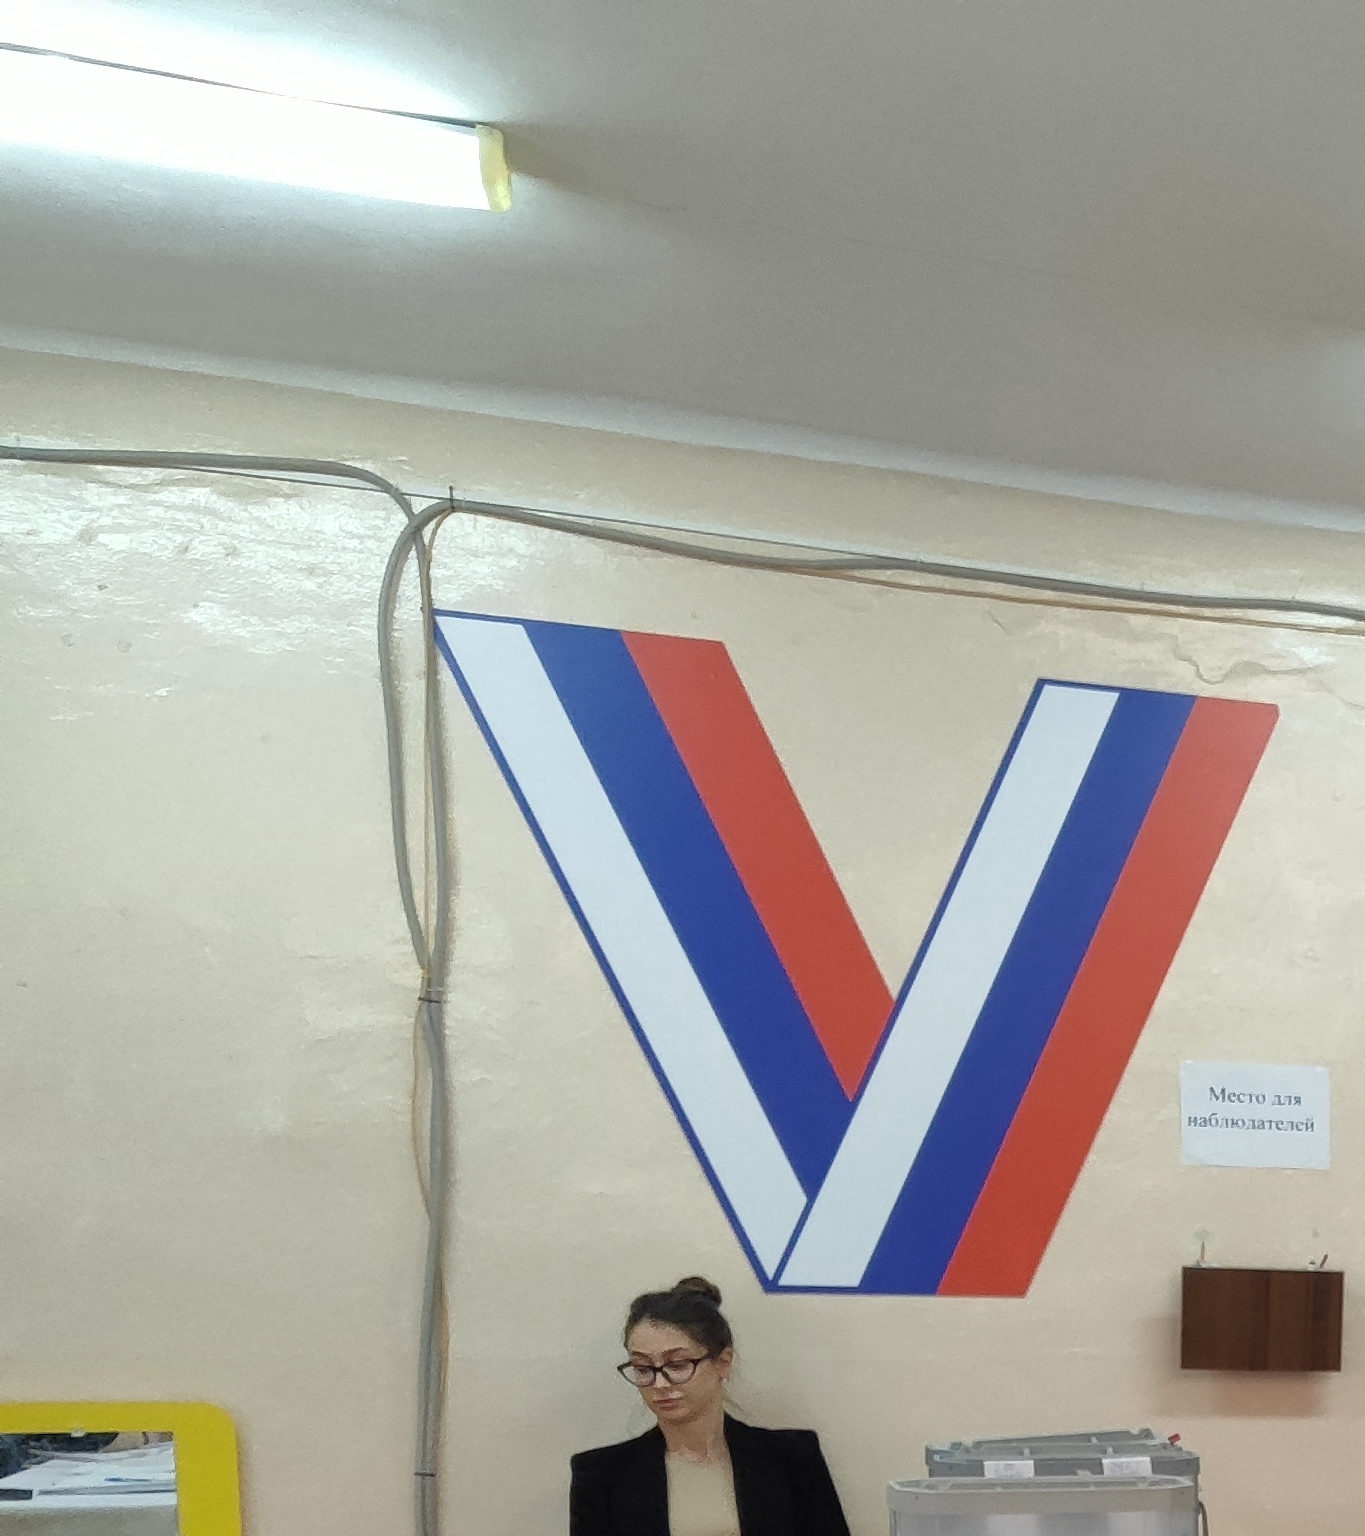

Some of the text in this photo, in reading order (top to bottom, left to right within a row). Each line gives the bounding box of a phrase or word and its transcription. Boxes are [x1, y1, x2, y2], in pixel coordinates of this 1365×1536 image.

[1208, 1086, 1302, 1107] Место для
[1187, 1112, 1315, 1133] наблюдателей
